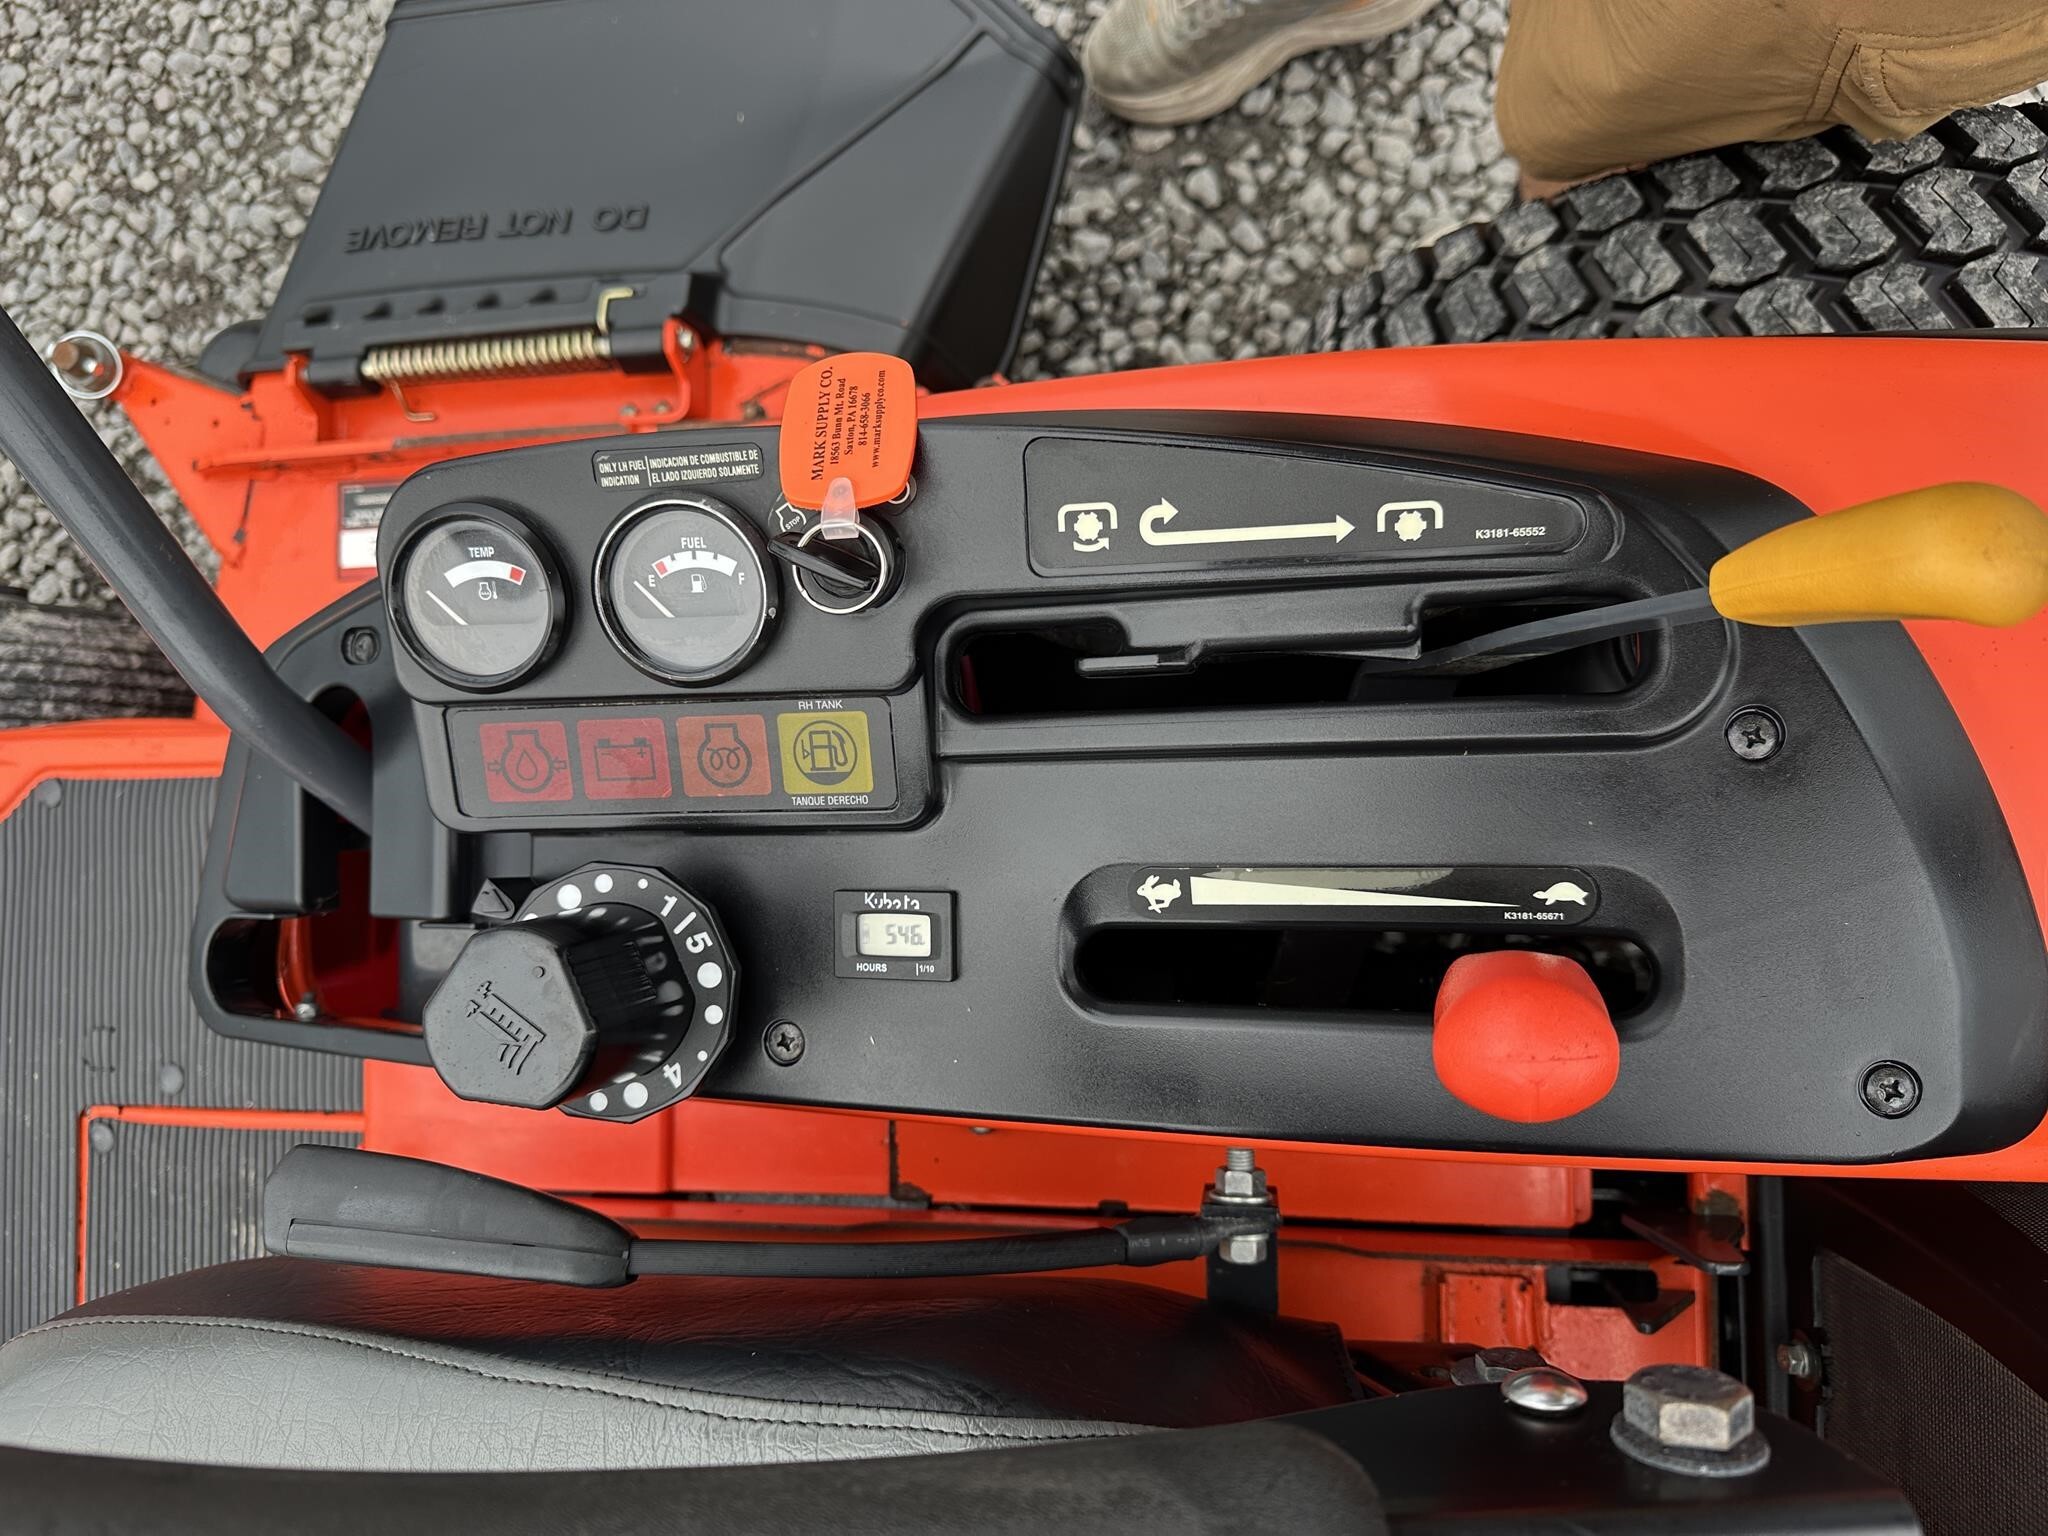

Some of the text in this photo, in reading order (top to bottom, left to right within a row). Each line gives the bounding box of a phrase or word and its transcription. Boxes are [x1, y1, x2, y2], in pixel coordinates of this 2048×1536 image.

[345, 204, 649, 254] DO NOT REMOVE
[811, 366, 833, 480] MARK SUPPLY CO.
[830, 378, 846, 464] 18563 Bunn Mt. Road
[844, 386, 858, 455] Saxton, PA 16678
[858, 392, 871, 446] 814-658-3066
[872, 370, 886, 468] www.marksupplyco.com
[600, 459, 646, 474] ONLY LH FUEL
[650, 449, 759, 469] INDICACION DE COMBUSTIBLE DE
[601, 474, 640, 487] INDICATION
[652, 464, 759, 483] EL LADO IZQUIERDO SOLAMENTE
[785, 515, 801, 530] STOP
[1475, 526, 1546, 539] K3181-65552
[680, 537, 707, 549] FUEL
[468, 546, 495, 558] TEMP
[648, 574, 656, 588] E
[738, 572, 745, 585] F
[798, 700, 843, 710] RH TANK
[791, 795, 869, 806] TANQUE DERECHO
[864, 892, 920, 910] Kubota
[1504, 912, 1564, 921] K3181-65671
[856, 963, 888, 973] HOURS
[662, 1062, 682, 1089] 4
